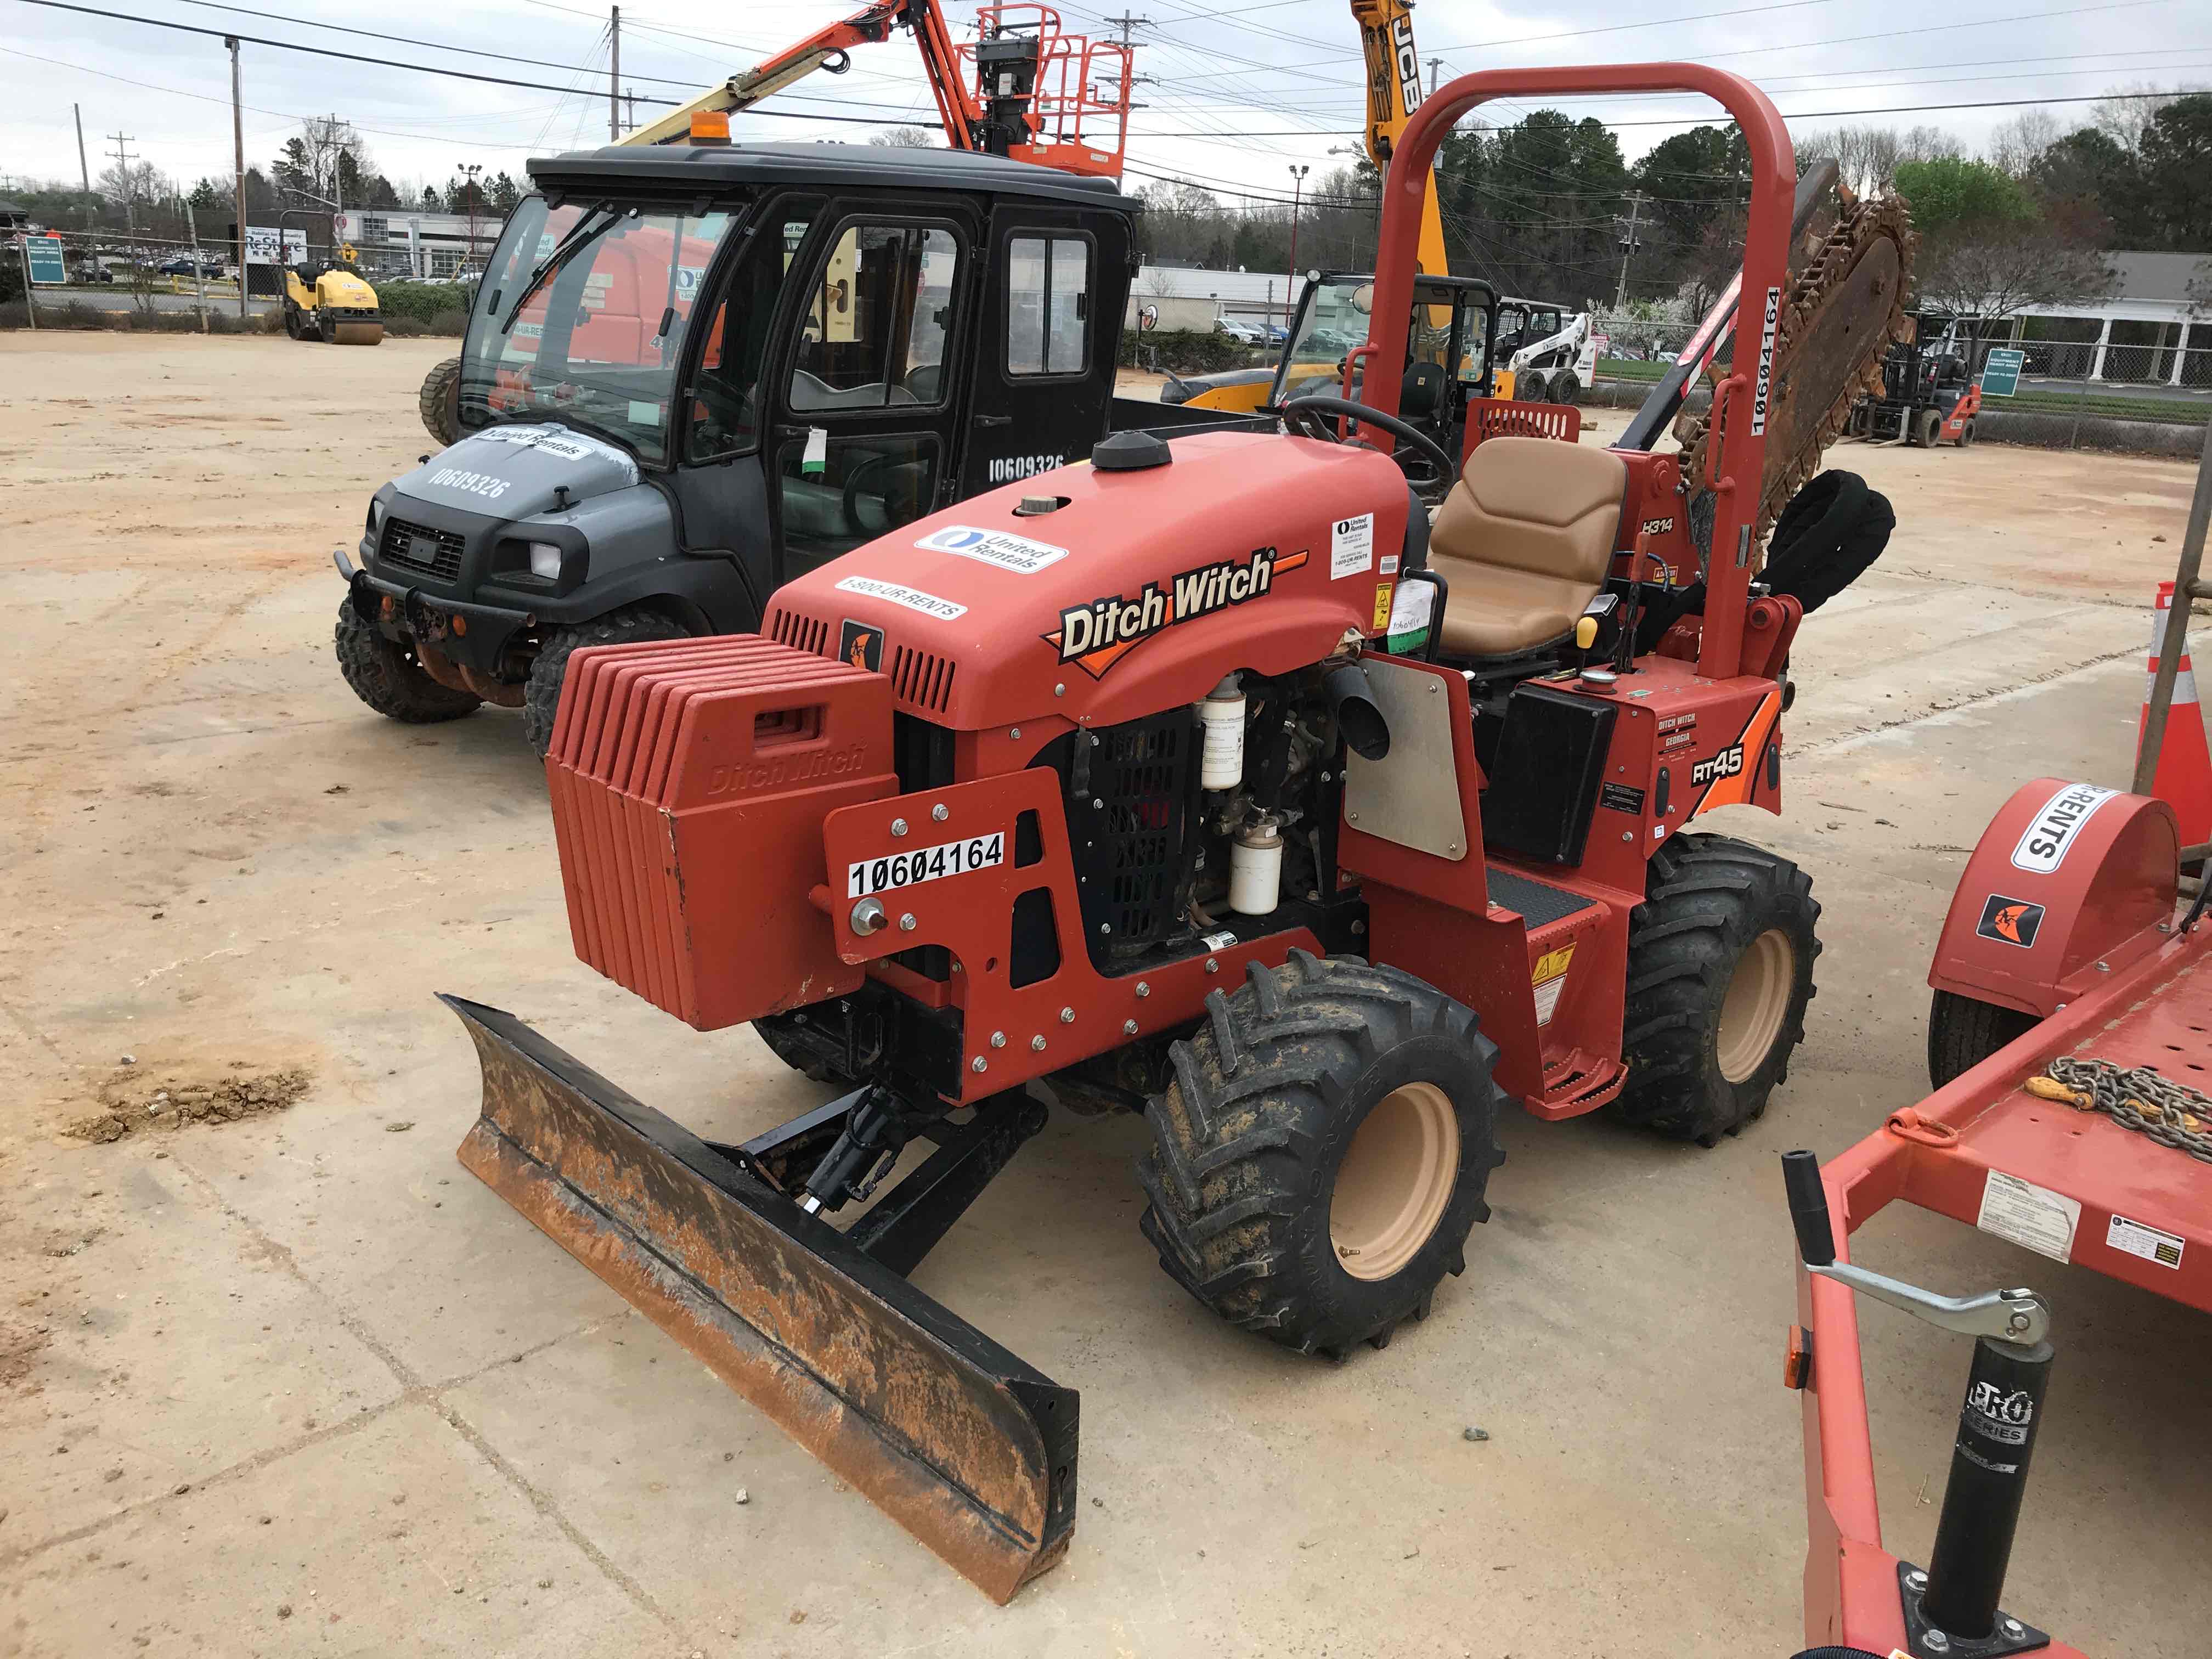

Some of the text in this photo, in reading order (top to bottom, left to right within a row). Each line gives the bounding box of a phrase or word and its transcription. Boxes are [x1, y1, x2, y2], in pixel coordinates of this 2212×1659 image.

[1393, 16, 1421, 114] JCB
[1753, 289, 1779, 432] 10604164
[493, 430, 580, 455] United Rentals
[428, 467, 511, 498] 10609326
[989, 455, 1064, 482] 10609326
[1351, 516, 1367, 526] United
[1351, 523, 1368, 532] Rentals
[1642, 518, 1673, 534] H314
[969, 543, 1037, 569] Rentals
[986, 535, 1052, 559] United
[842, 579, 960, 616] 1-800-UR-RENTS
[1063, 552, 1271, 658] Ditch Witch
[1658, 713, 1695, 730] DITCH WITCH
[1666, 732, 1690, 747] GEORGIA
[708, 747, 866, 795] Ditch Witch
[1693, 747, 1742, 783] RT45
[852, 835, 1002, 895] 10604164
[1970, 1383, 2030, 1423] PRO
